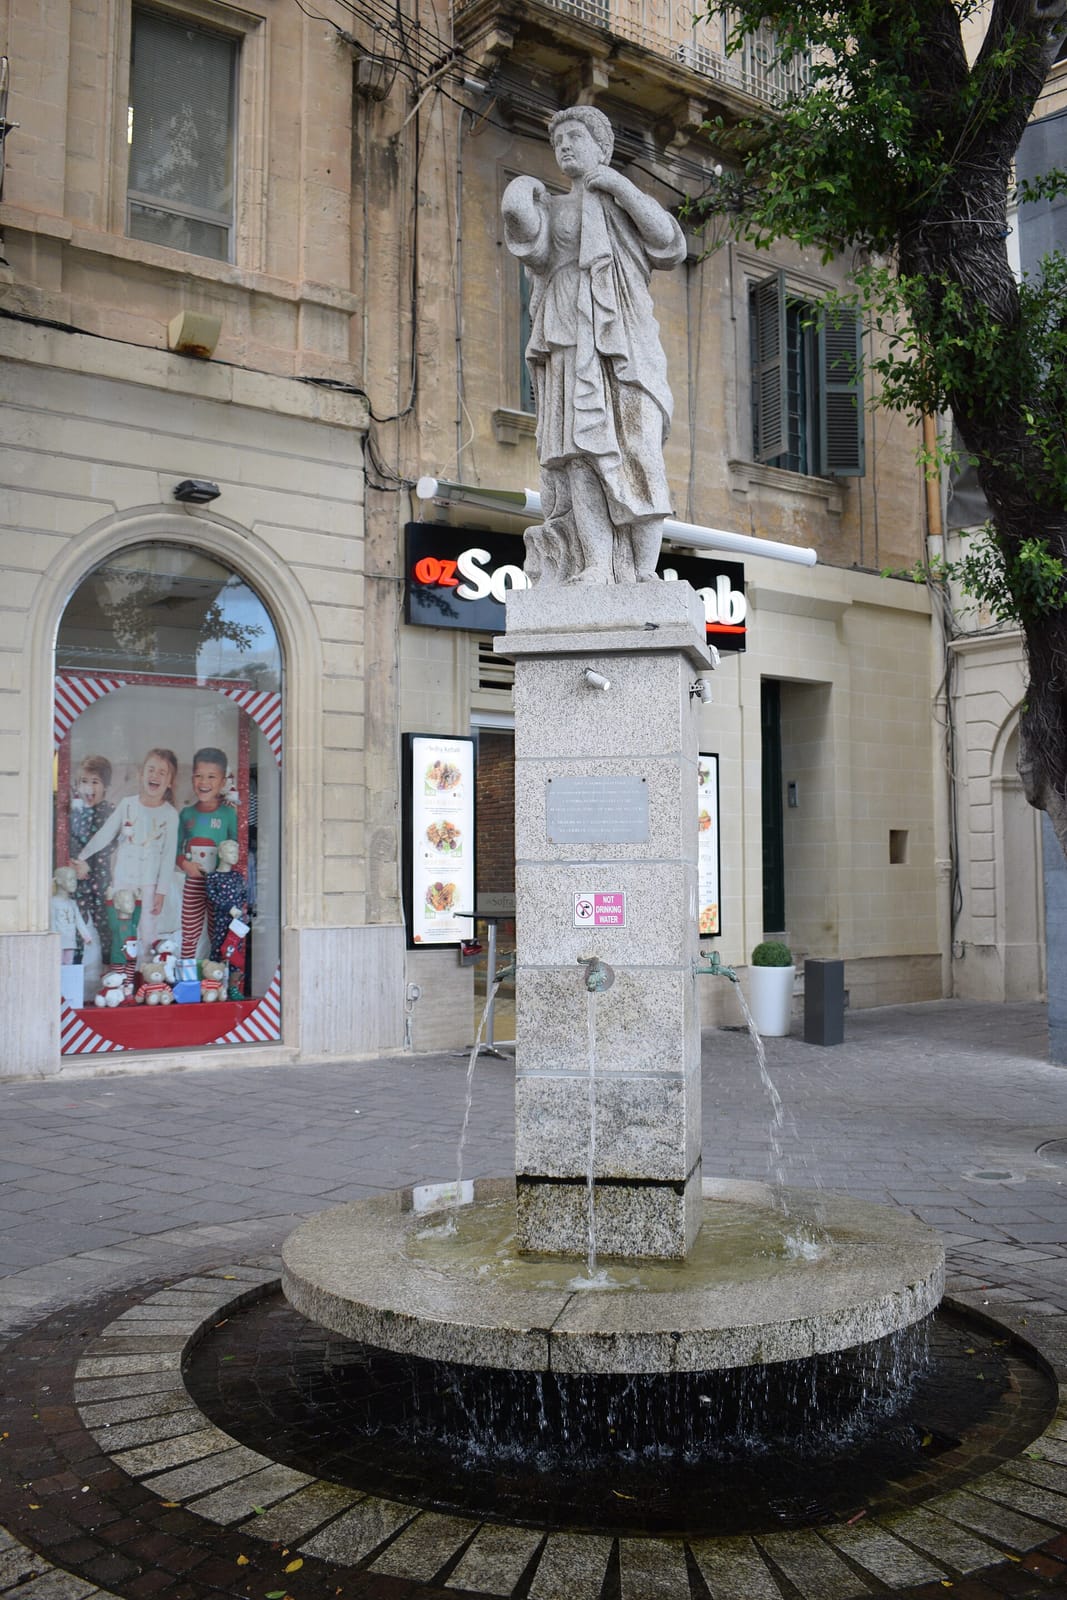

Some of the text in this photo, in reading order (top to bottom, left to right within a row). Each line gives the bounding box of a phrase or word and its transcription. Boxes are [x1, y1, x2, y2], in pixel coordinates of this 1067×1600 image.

[415, 548, 532, 603] ozSo
[602, 895, 614, 904] NOT
[595, 905, 622, 914] DRINKING
[599, 915, 619, 924] WATER
